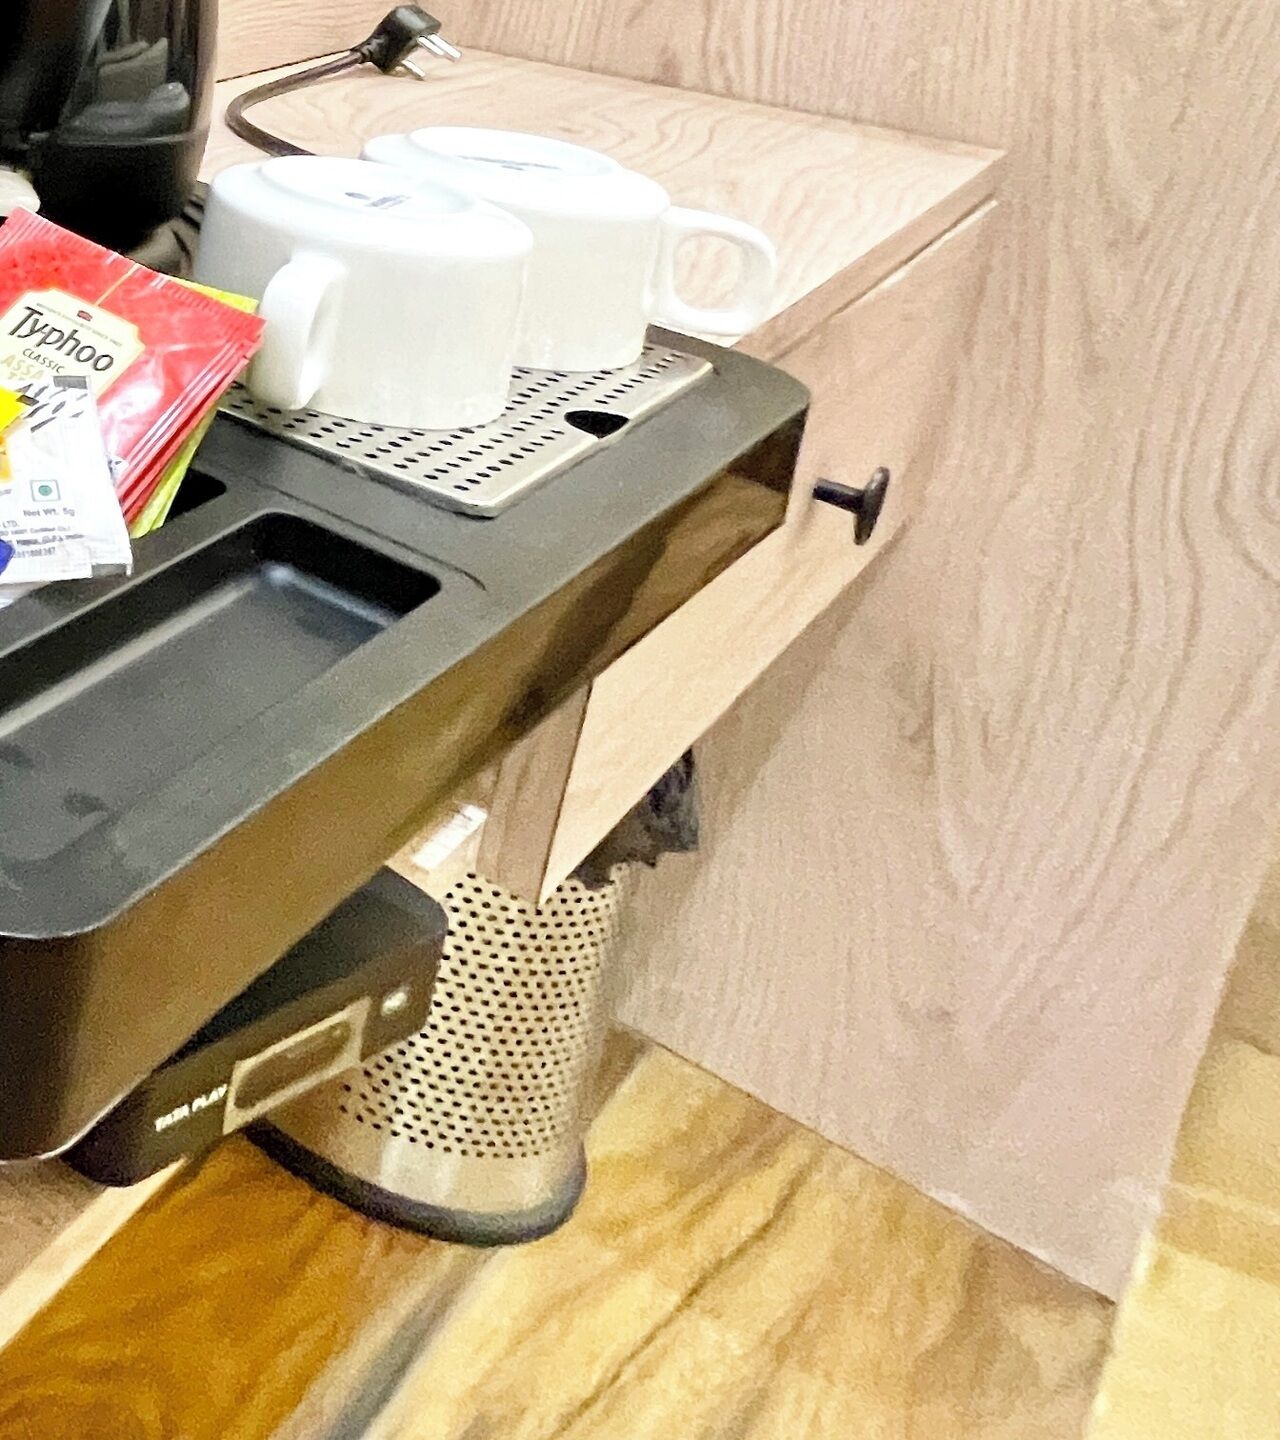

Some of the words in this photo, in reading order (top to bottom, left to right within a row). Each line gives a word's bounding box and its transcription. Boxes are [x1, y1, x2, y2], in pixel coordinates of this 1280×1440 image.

[0, 353, 45, 381] ASSA
[22, 348, 66, 374] CLASSIC
[23, 509, 41, 517] Net
[191, 1083, 228, 1113] PLAY
